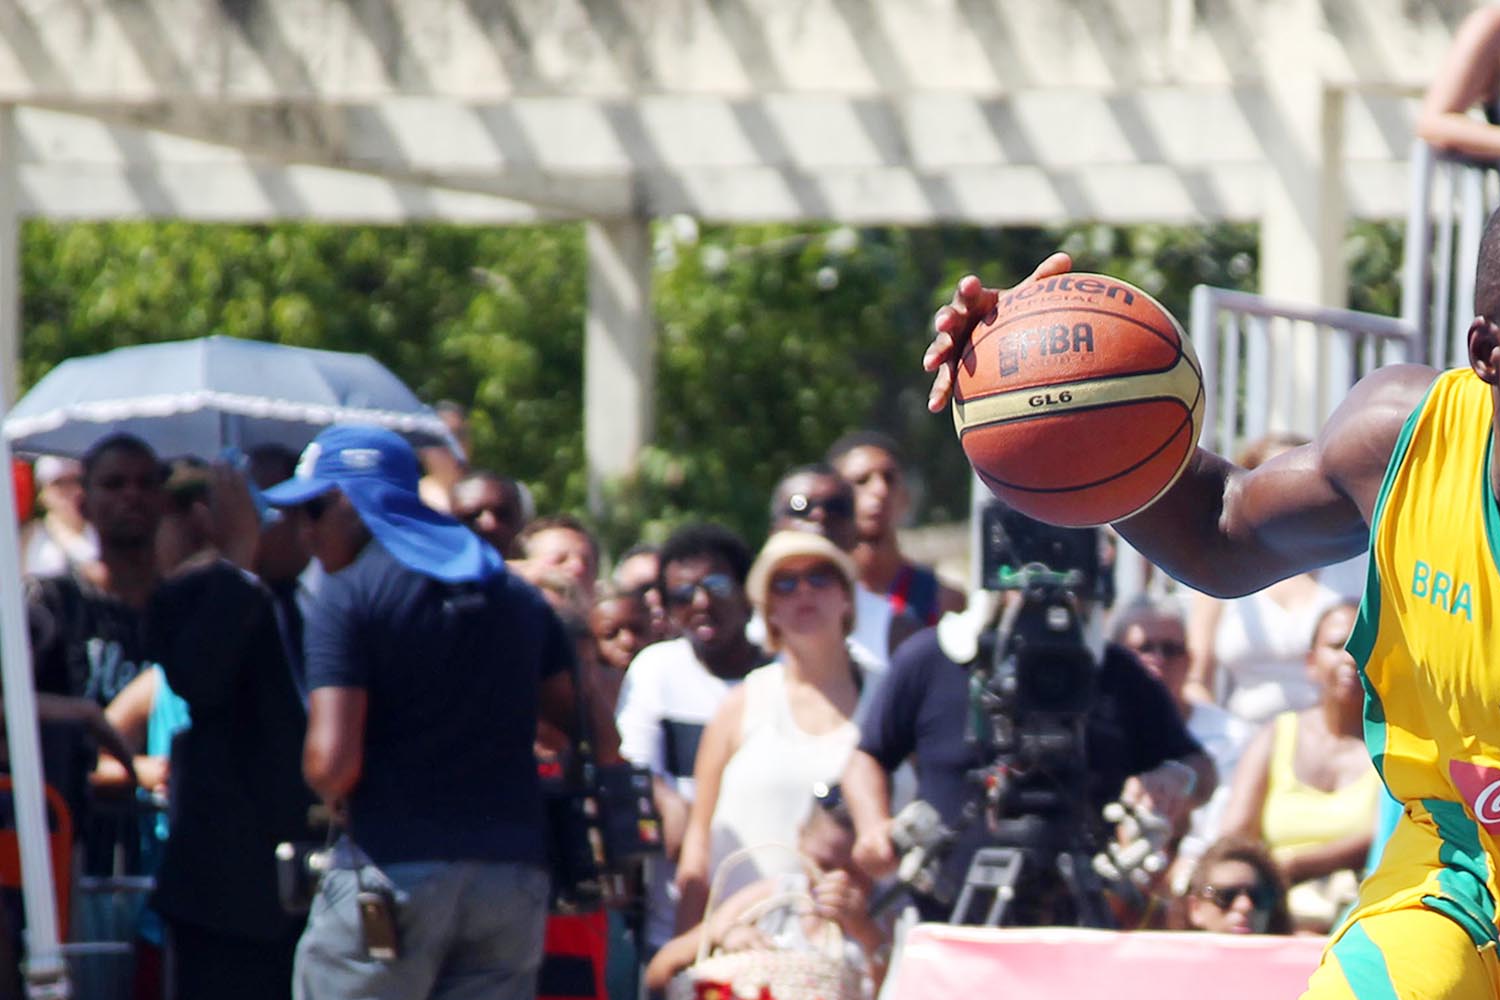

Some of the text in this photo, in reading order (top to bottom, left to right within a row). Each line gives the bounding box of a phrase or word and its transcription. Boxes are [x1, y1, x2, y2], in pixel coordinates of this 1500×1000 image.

[1020, 322, 1094, 360] FIBA
[1029, 391, 1072, 407] GL6
[1411, 560, 1473, 622] BRA
